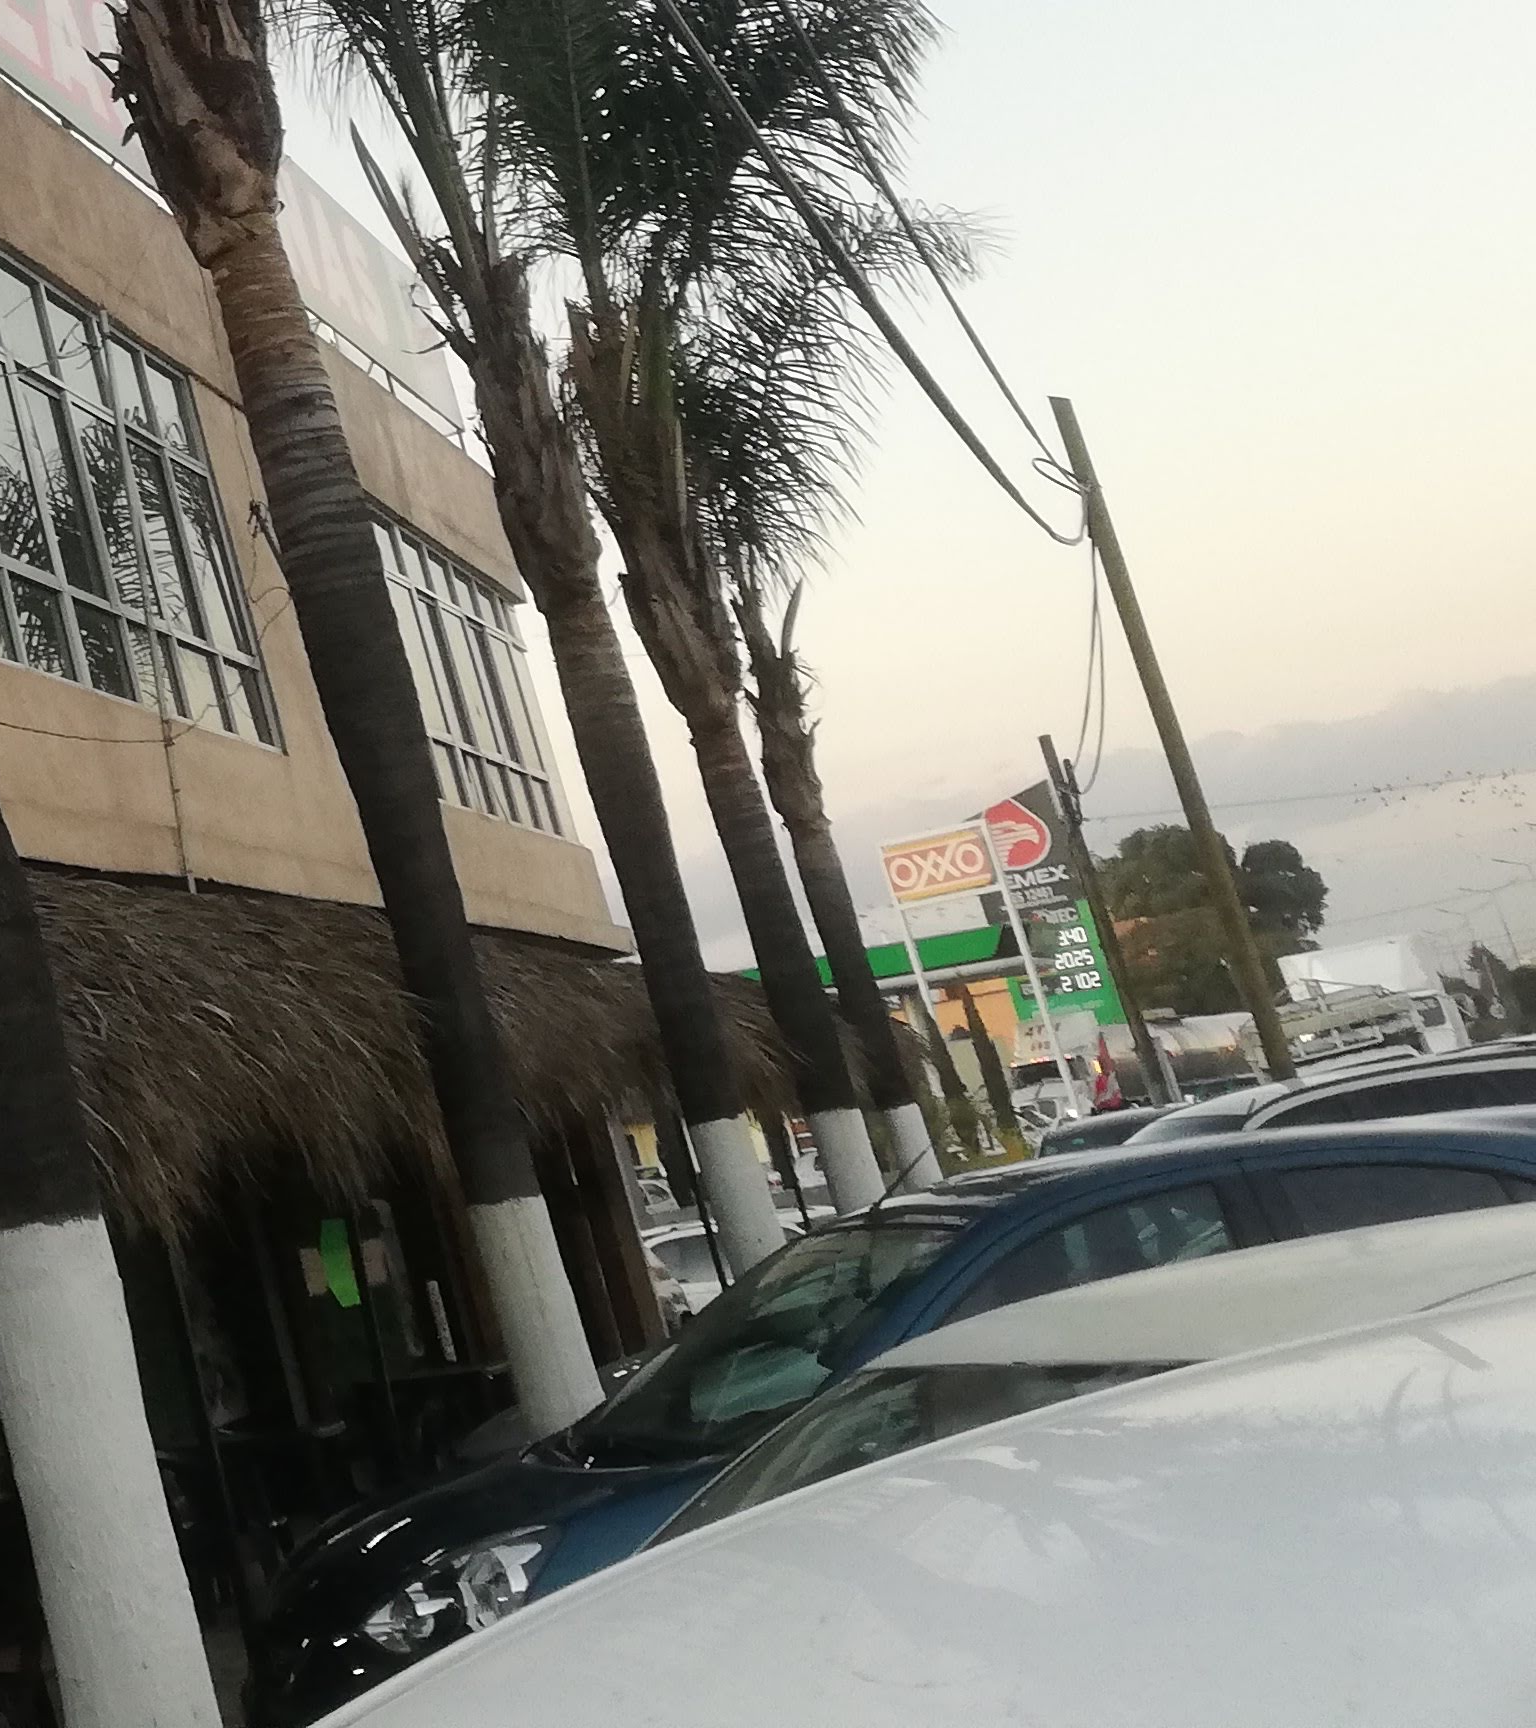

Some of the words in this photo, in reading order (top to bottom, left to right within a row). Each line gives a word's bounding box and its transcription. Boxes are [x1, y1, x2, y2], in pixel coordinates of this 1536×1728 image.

[889, 842, 985, 891] OXXO
[1005, 864, 1070, 889] EMEX
[1055, 948, 1095, 970] 2025
